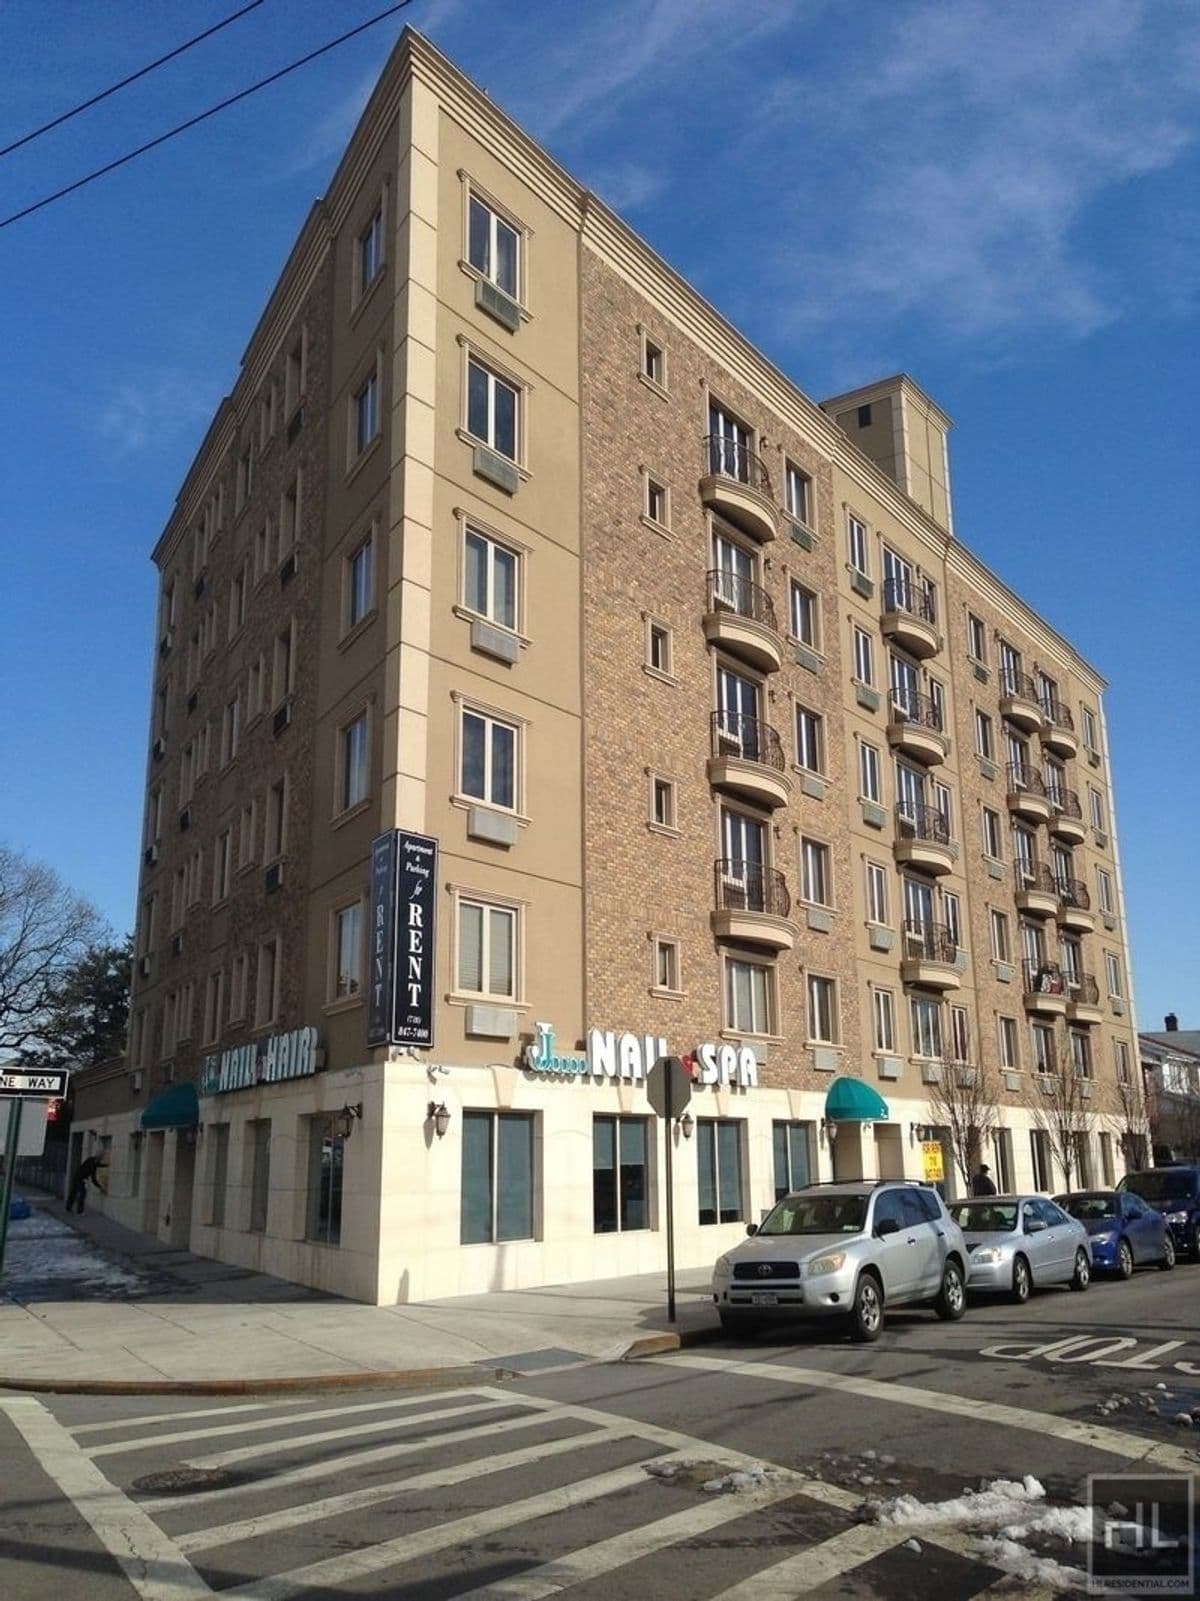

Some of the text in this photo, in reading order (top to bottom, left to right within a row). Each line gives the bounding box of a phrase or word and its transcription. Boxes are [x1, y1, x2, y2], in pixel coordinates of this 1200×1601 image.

[405, 861, 430, 879] Parking
[375, 904, 385, 1007] RENT
[408, 902, 423, 1008] RENT
[266, 1026, 318, 1081] HAIR
[697, 1043, 758, 1087] SPA
[0, 1076, 55, 1089] NE WAY
[979, 1335, 1200, 1375] TOP
